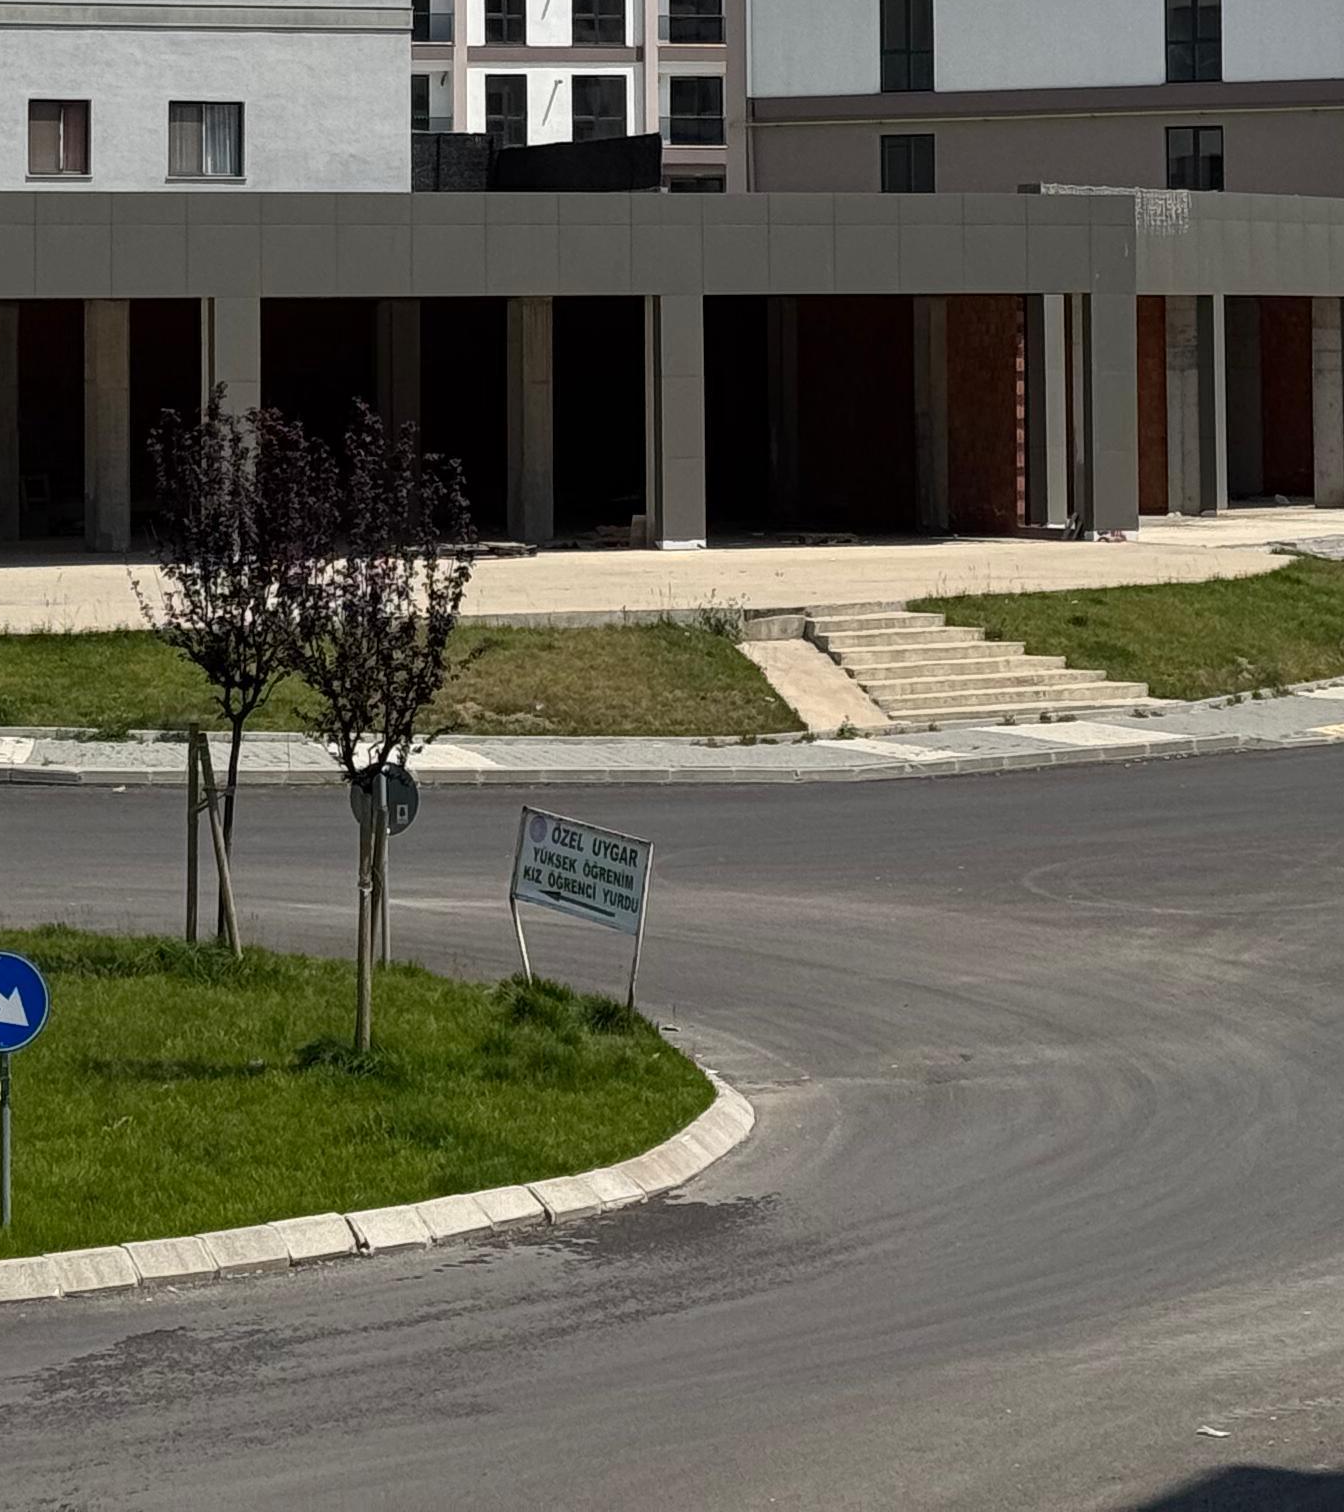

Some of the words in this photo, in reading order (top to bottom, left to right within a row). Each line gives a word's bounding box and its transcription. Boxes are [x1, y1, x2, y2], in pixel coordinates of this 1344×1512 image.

[533, 845, 578, 874] YÜKSEK
[583, 859, 634, 891] ÖĞRENİM
[552, 823, 584, 852] ÖZEL
[592, 837, 638, 868] UYGAR
[523, 865, 543, 884] KIZ
[548, 871, 596, 900] ÖĞRENCİ
[603, 888, 639, 914] YURDU
